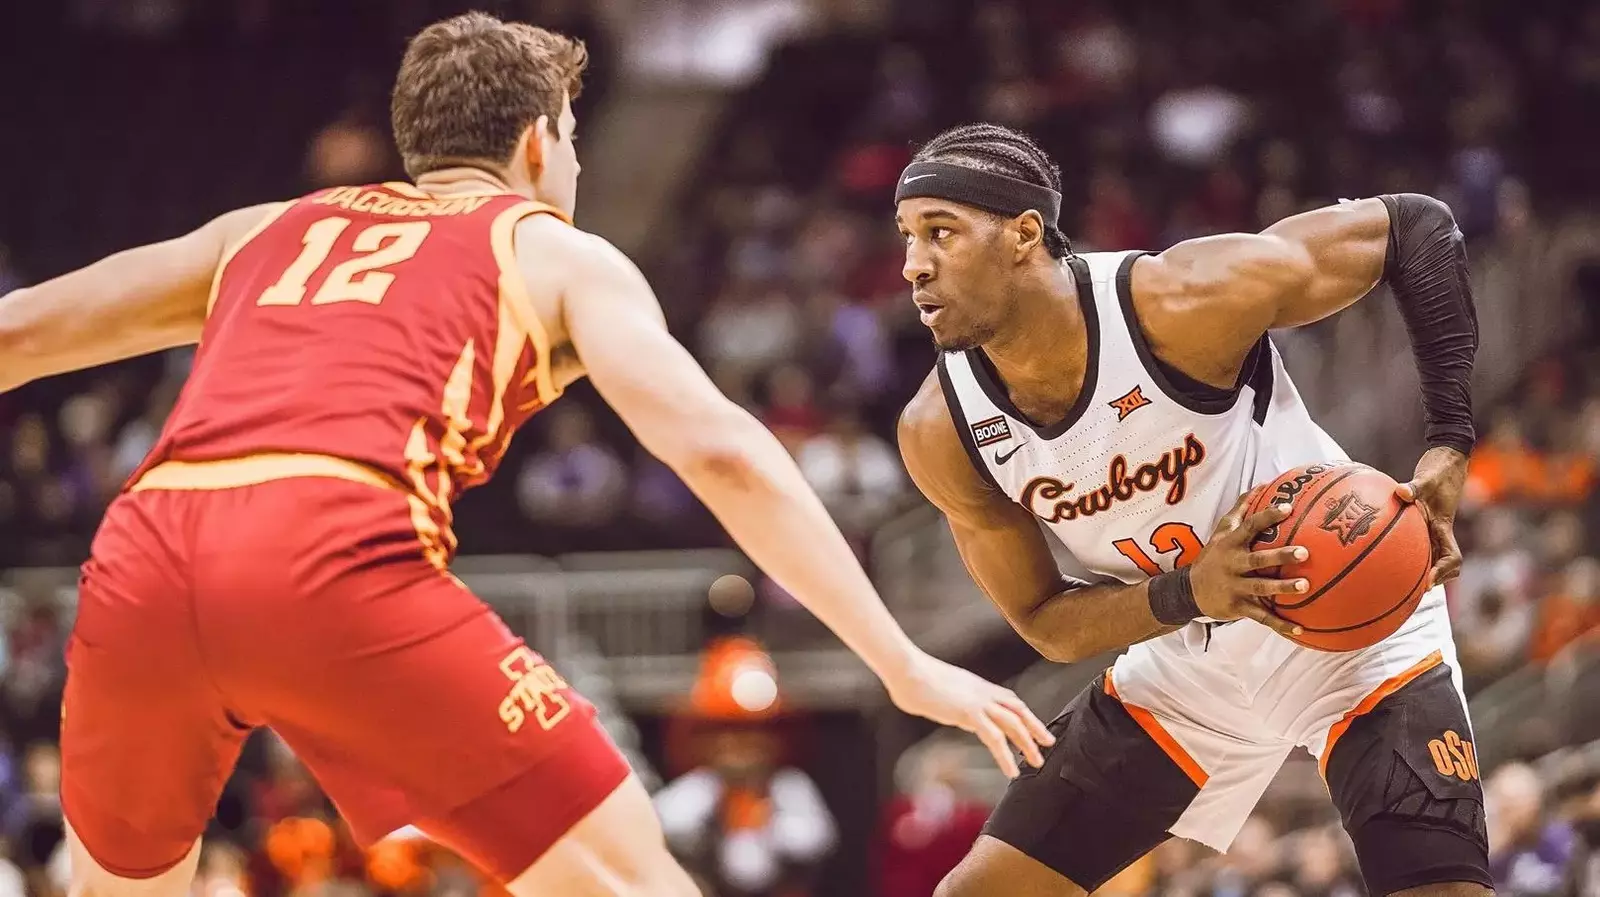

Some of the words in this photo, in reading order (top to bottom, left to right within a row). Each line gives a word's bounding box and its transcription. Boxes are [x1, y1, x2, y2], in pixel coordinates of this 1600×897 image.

[256, 216, 431, 306] 12
[975, 421, 1008, 441] BOONE
[1020, 433, 1206, 523] Cowboys
